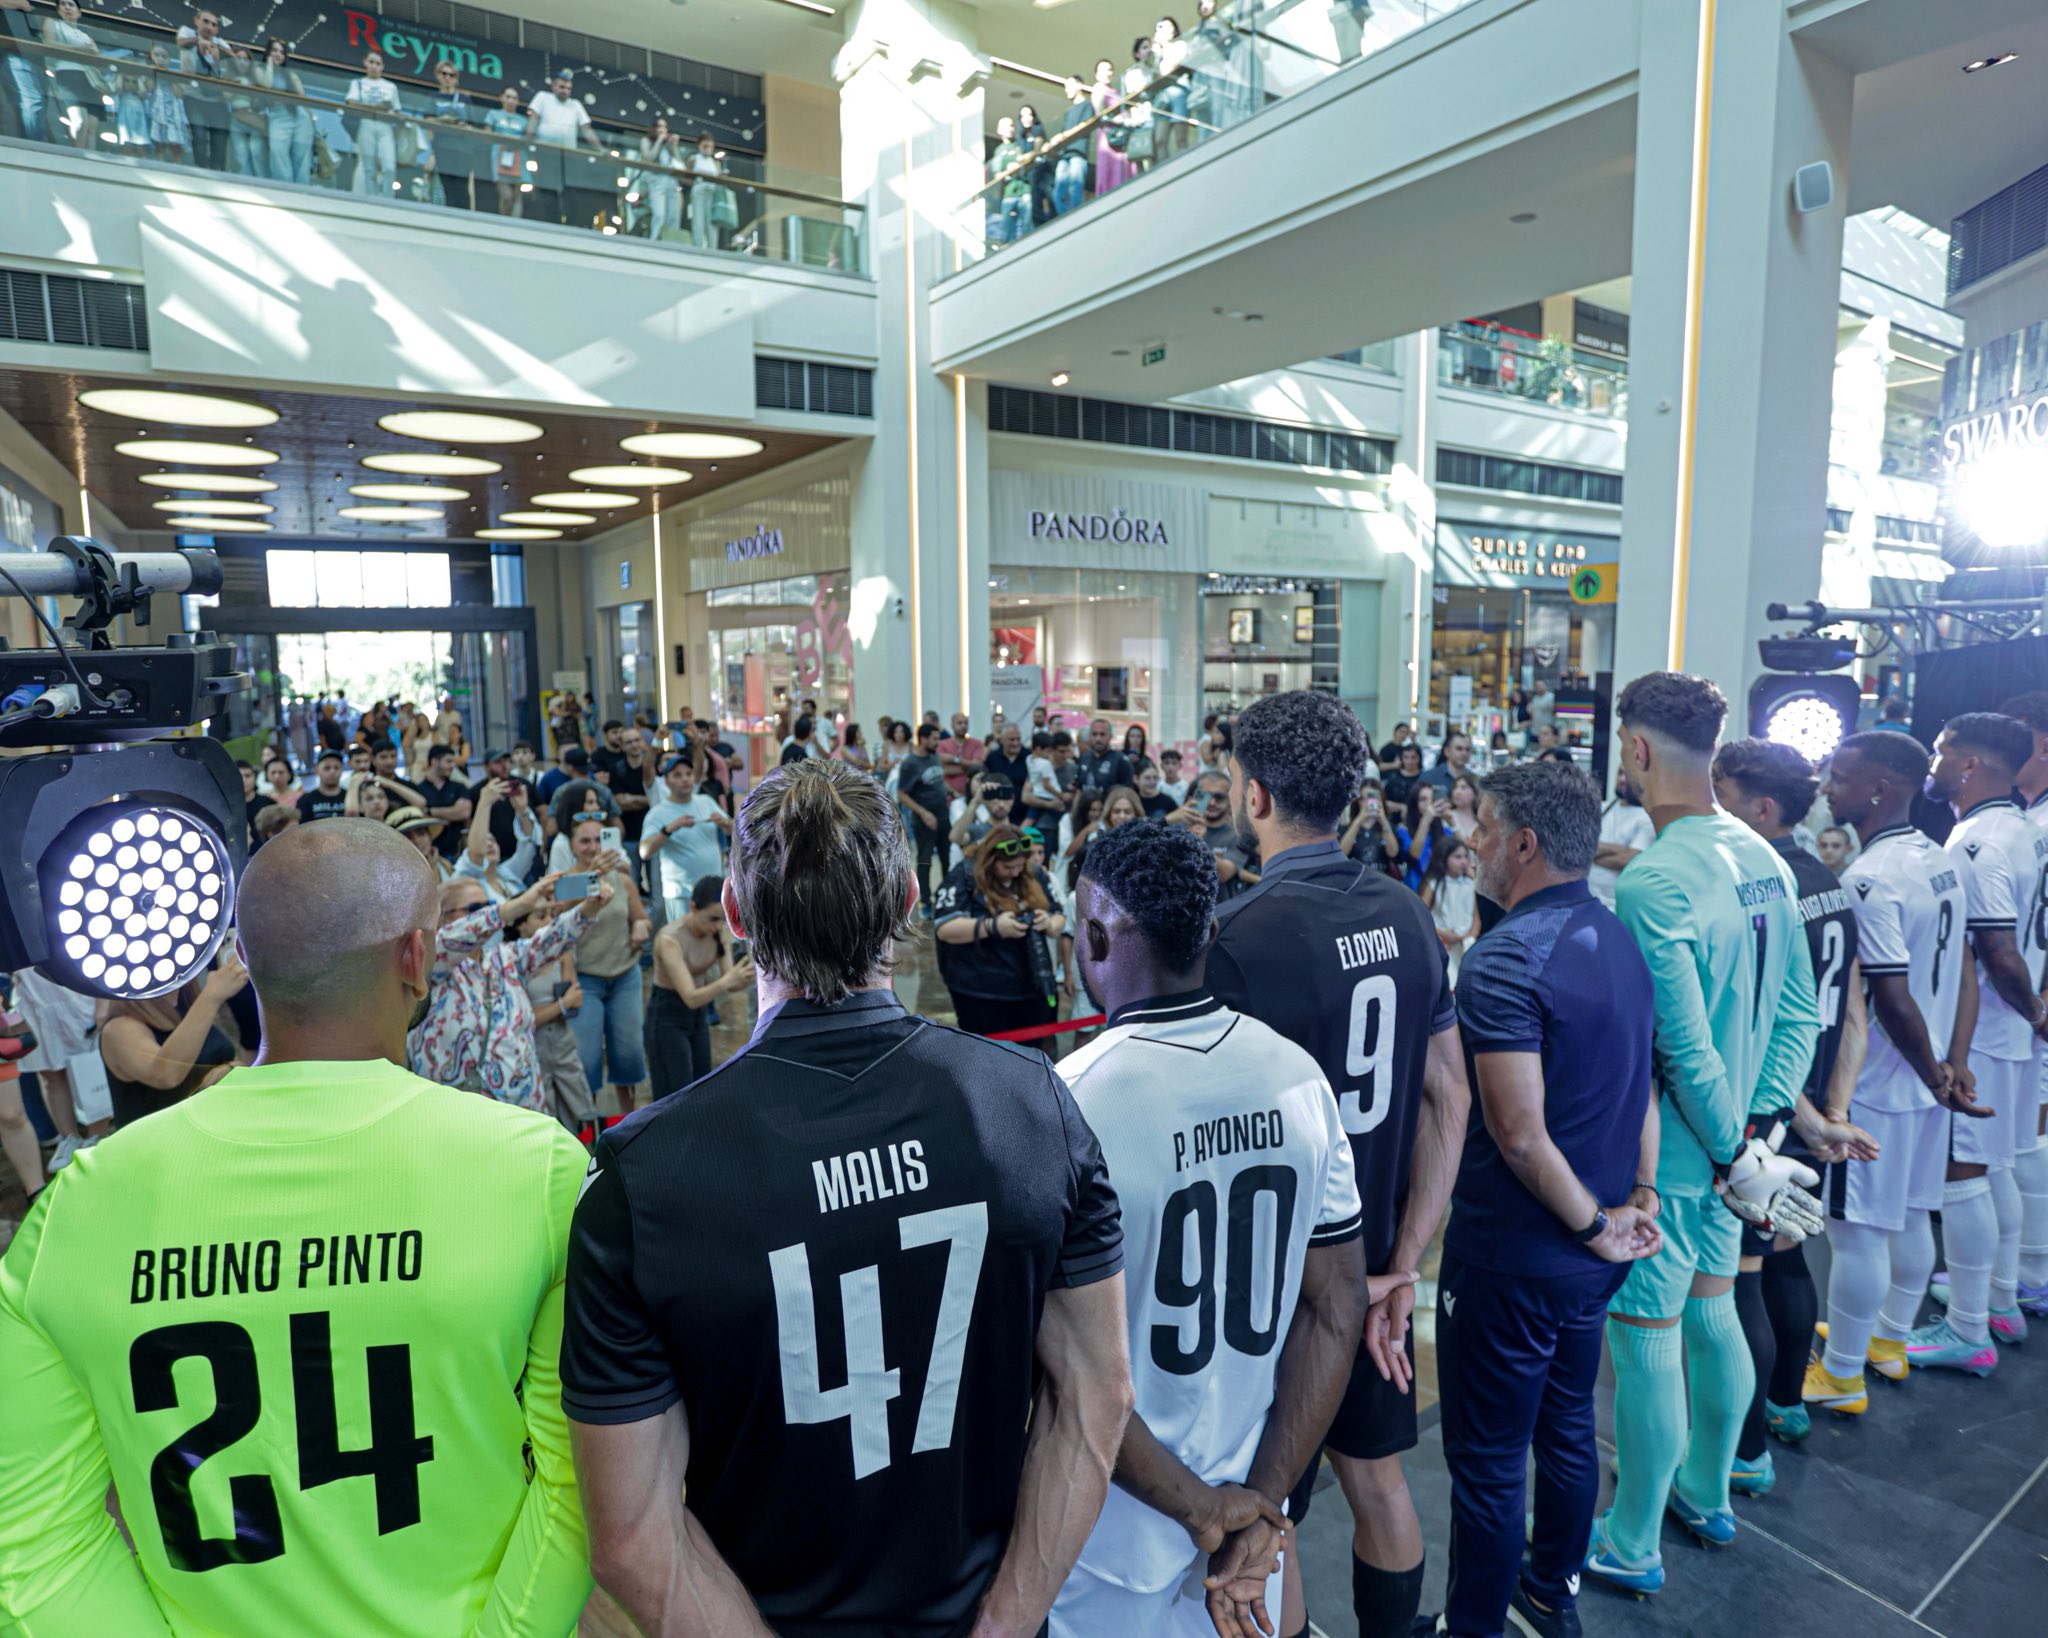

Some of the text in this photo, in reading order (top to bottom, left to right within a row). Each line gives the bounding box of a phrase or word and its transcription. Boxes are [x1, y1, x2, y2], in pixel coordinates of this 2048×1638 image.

[343, 9, 503, 80] Reyma
[725, 524, 784, 563] PANDORA
[1028, 506, 1168, 544] PANDORA
[1472, 556, 1529, 576] CHARLES
[1536, 560, 1544, 577] &
[1335, 926, 1399, 970] ELOYAN
[1752, 913, 1768, 1032] 1
[1817, 920, 1845, 1032] 2
[1339, 974, 1397, 1135] 9
[1193, 1109, 1284, 1164] AYONGO
[812, 1139, 929, 1214] MALIS
[130, 1230, 422, 1304] BRUNO PINTO
[1150, 1165, 1298, 1376] 90
[768, 1201, 989, 1480] 47
[129, 1311, 434, 1573] 24
